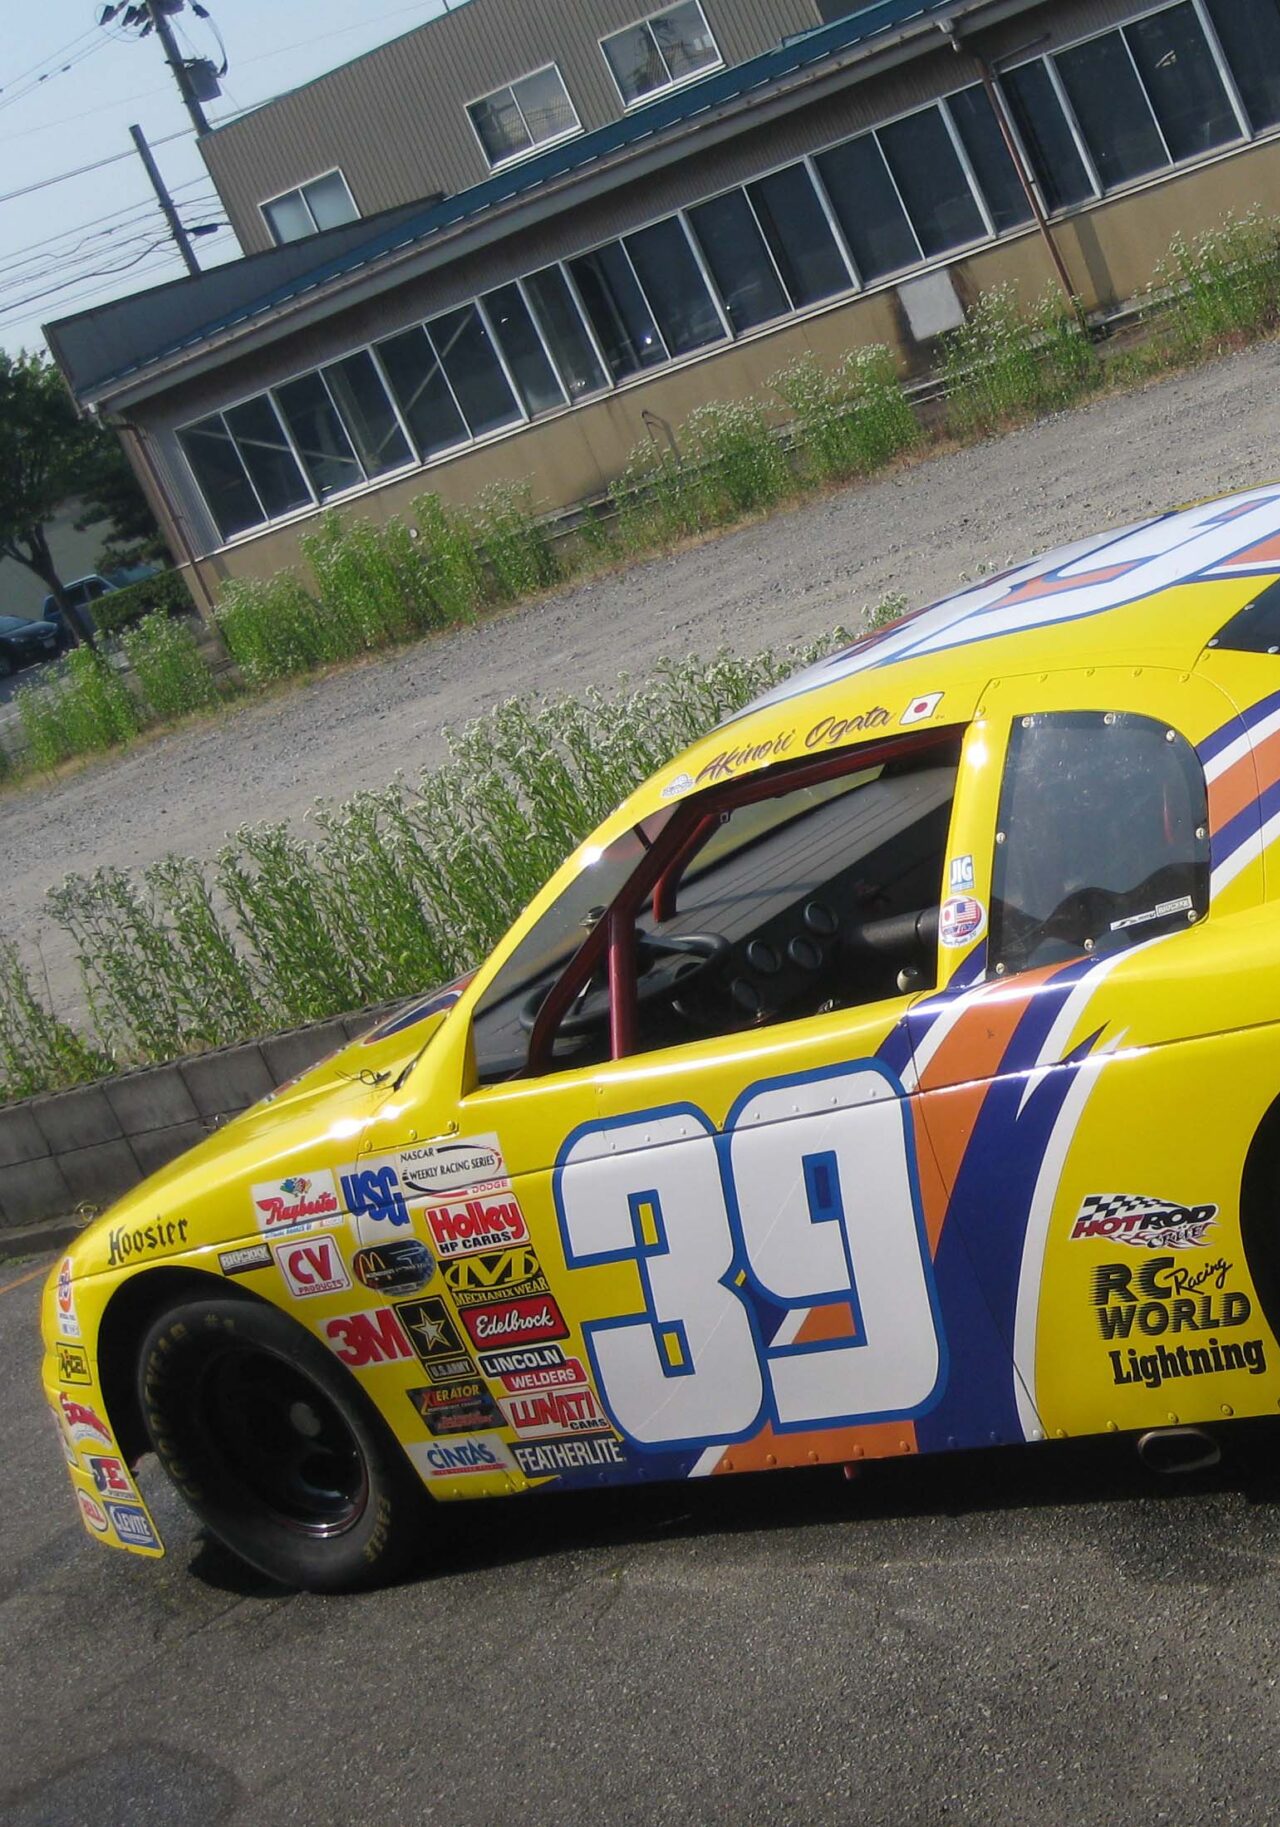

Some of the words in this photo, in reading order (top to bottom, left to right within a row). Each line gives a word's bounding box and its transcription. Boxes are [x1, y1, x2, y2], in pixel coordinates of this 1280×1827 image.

[805, 706, 892, 748] Ogata
[951, 856, 973, 885] JIG
[400, 1147, 435, 1163] NASCAR
[409, 1166, 438, 1180] WEEKLY
[440, 1160, 470, 1175] RACING
[471, 1155, 495, 1170] SERIES
[340, 1166, 410, 1226] USG
[472, 1180, 508, 1193] DODGE
[427, 1201, 525, 1243] Holley
[107, 1215, 189, 1266] Hoosier
[438, 1242, 459, 1254] HP
[462, 1231, 512, 1249] CARBS
[555, 1058, 947, 1452] 39
[289, 1244, 332, 1284] CV
[1089, 1257, 1175, 1306] RC
[1164, 1258, 1233, 1295] Racing
[298, 1280, 344, 1294] PRODUCTS
[454, 1286, 514, 1306] MECHANIX
[513, 1278, 548, 1296] WEAR
[475, 1310, 555, 1339] Edelbrock
[1096, 1292, 1251, 1340] WORLD
[326, 1308, 414, 1366] 3M
[484, 1348, 562, 1374] LINCOLN
[510, 1367, 577, 1390] WELDERS
[1108, 1338, 1267, 1388] Lightning
[510, 1392, 596, 1428] LUNATI
[569, 1418, 610, 1431] CAMS
[514, 1438, 624, 1473] FEATHERLITE
